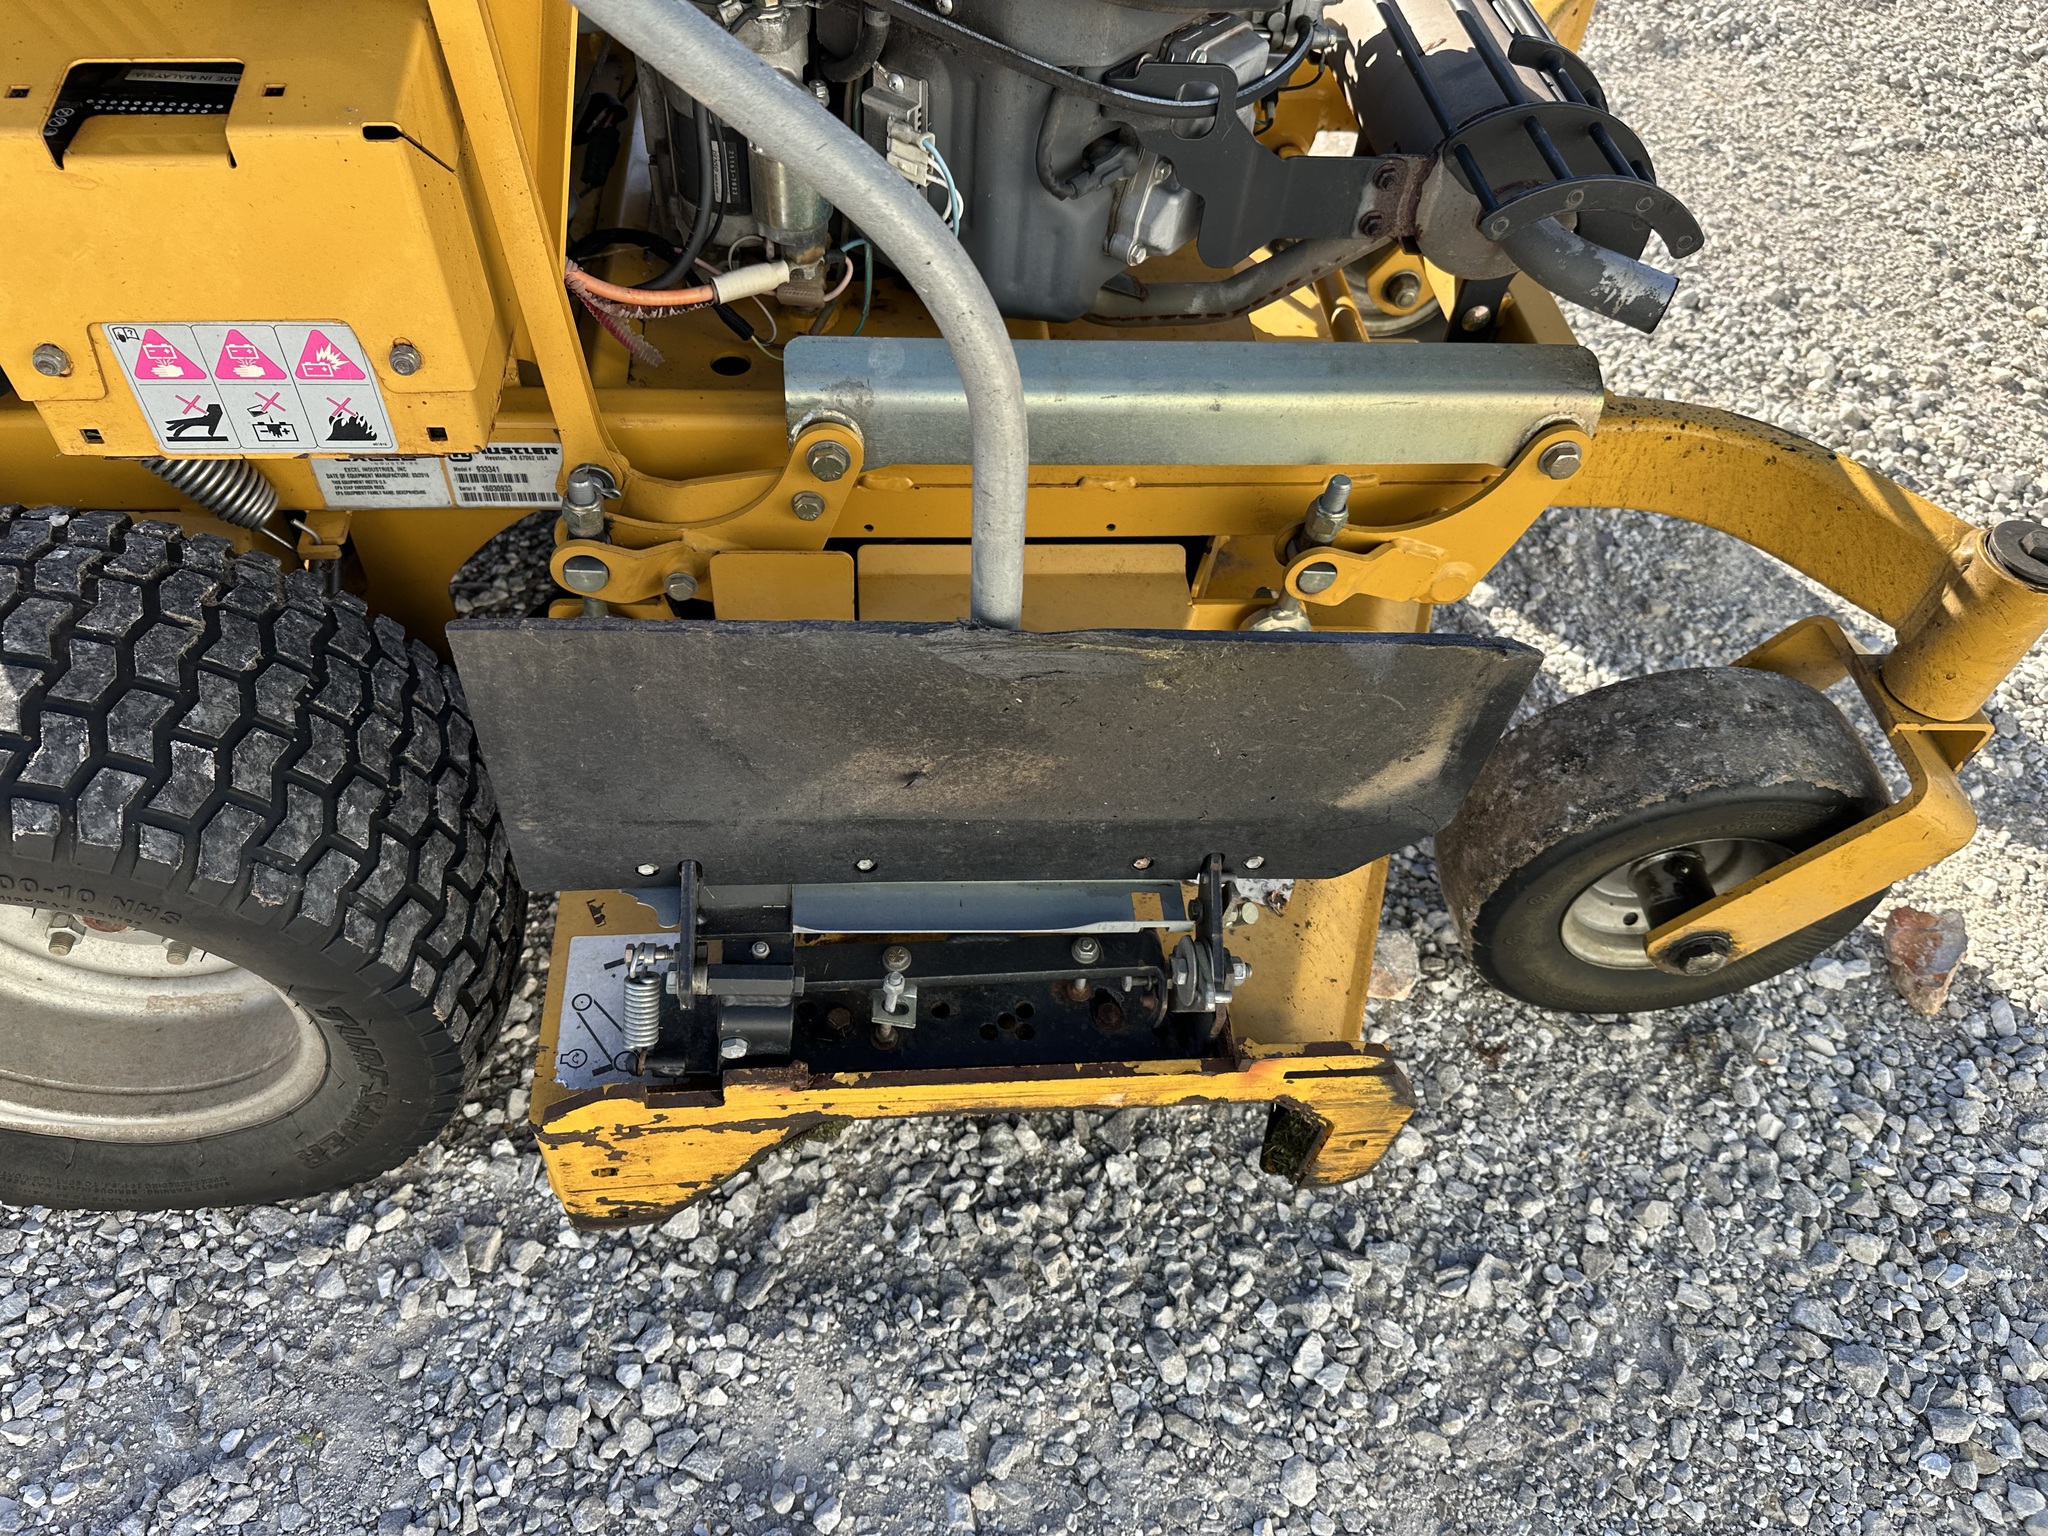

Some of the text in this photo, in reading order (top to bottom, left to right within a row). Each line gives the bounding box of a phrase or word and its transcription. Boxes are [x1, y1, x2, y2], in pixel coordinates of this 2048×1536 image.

[134, 72, 197, 81] MALAYSIA
[476, 465, 500, 473] 933341
[111, 894, 183, 925] NHS
